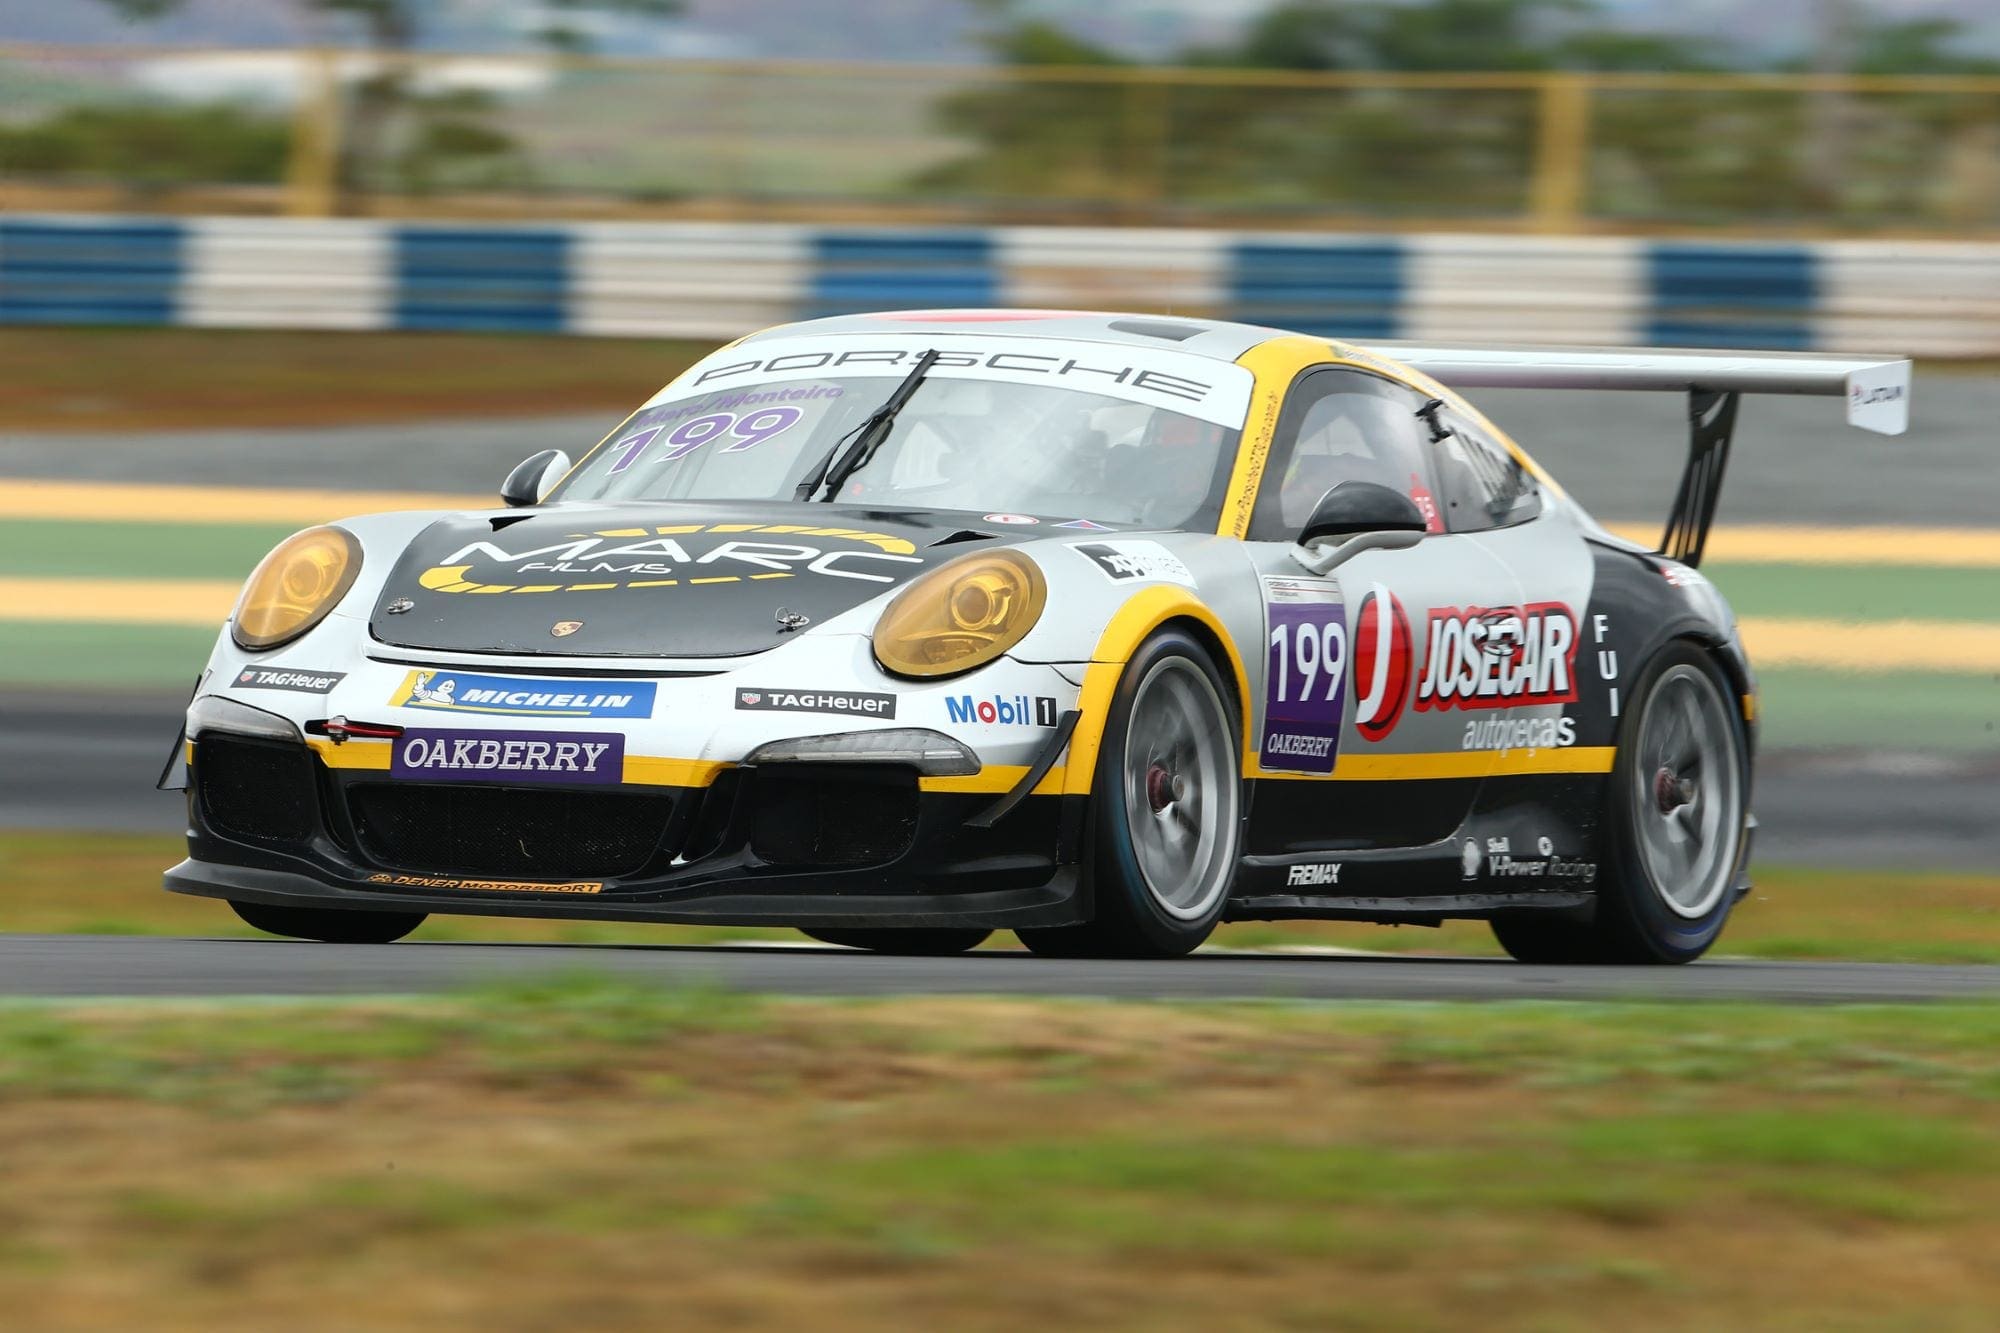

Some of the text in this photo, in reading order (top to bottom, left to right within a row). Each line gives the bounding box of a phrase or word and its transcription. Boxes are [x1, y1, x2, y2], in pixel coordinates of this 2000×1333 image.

[694, 349, 1213, 403] PORSCHE
[605, 405, 805, 476] 199
[440, 537, 924, 583] MARC
[516, 561, 673, 576] FILMS
[1270, 622, 1347, 702] 199
[1419, 612, 1573, 699] JOSECAR
[462, 687, 633, 709] MICHELIN
[944, 695, 1031, 725] Mobil
[403, 737, 610, 773] OAKBERRY
[1267, 732, 1334, 758] OAKBERRY
[1286, 862, 1343, 886] FREMAX
[1488, 855, 1548, 877] V-Power
[392, 876, 600, 894] DENER MOTORSPORT
